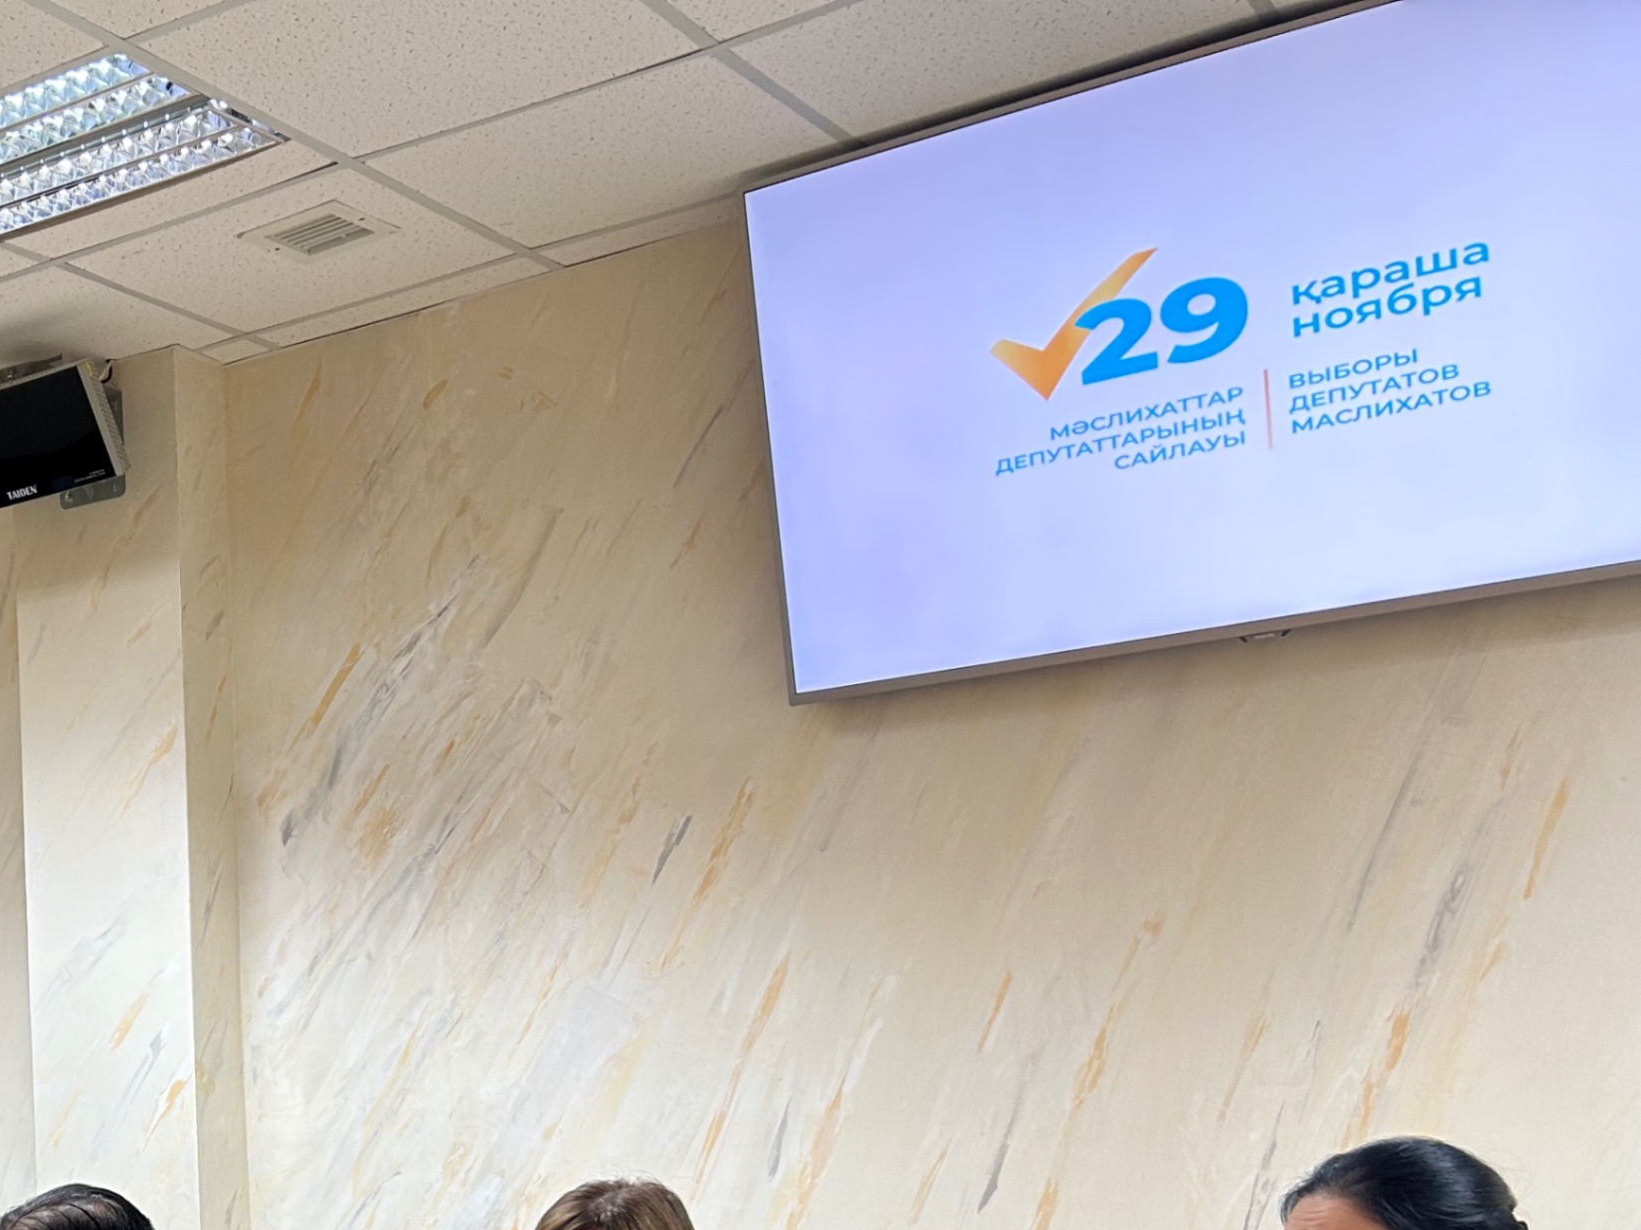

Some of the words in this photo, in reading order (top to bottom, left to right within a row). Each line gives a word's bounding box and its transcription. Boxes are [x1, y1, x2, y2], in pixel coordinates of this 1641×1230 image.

[1291, 242, 1490, 305] қараша
[1071, 277, 1248, 385] 29
[1292, 276, 1482, 338] ноября
[1288, 363, 1460, 414] ДЕПУТАТОВ
[1289, 348, 1419, 389] ВЫБОРЫ
[1049, 386, 1244, 441] МӘСЛИХАТТАР
[1290, 381, 1492, 434] МАСЛИХАТОВ
[995, 408, 1246, 476] ДЕПУТАТТАРЫНЫҢ
[1114, 430, 1246, 470] САЙЛАУЫ
[6, 485, 38, 501] TAIDEN
